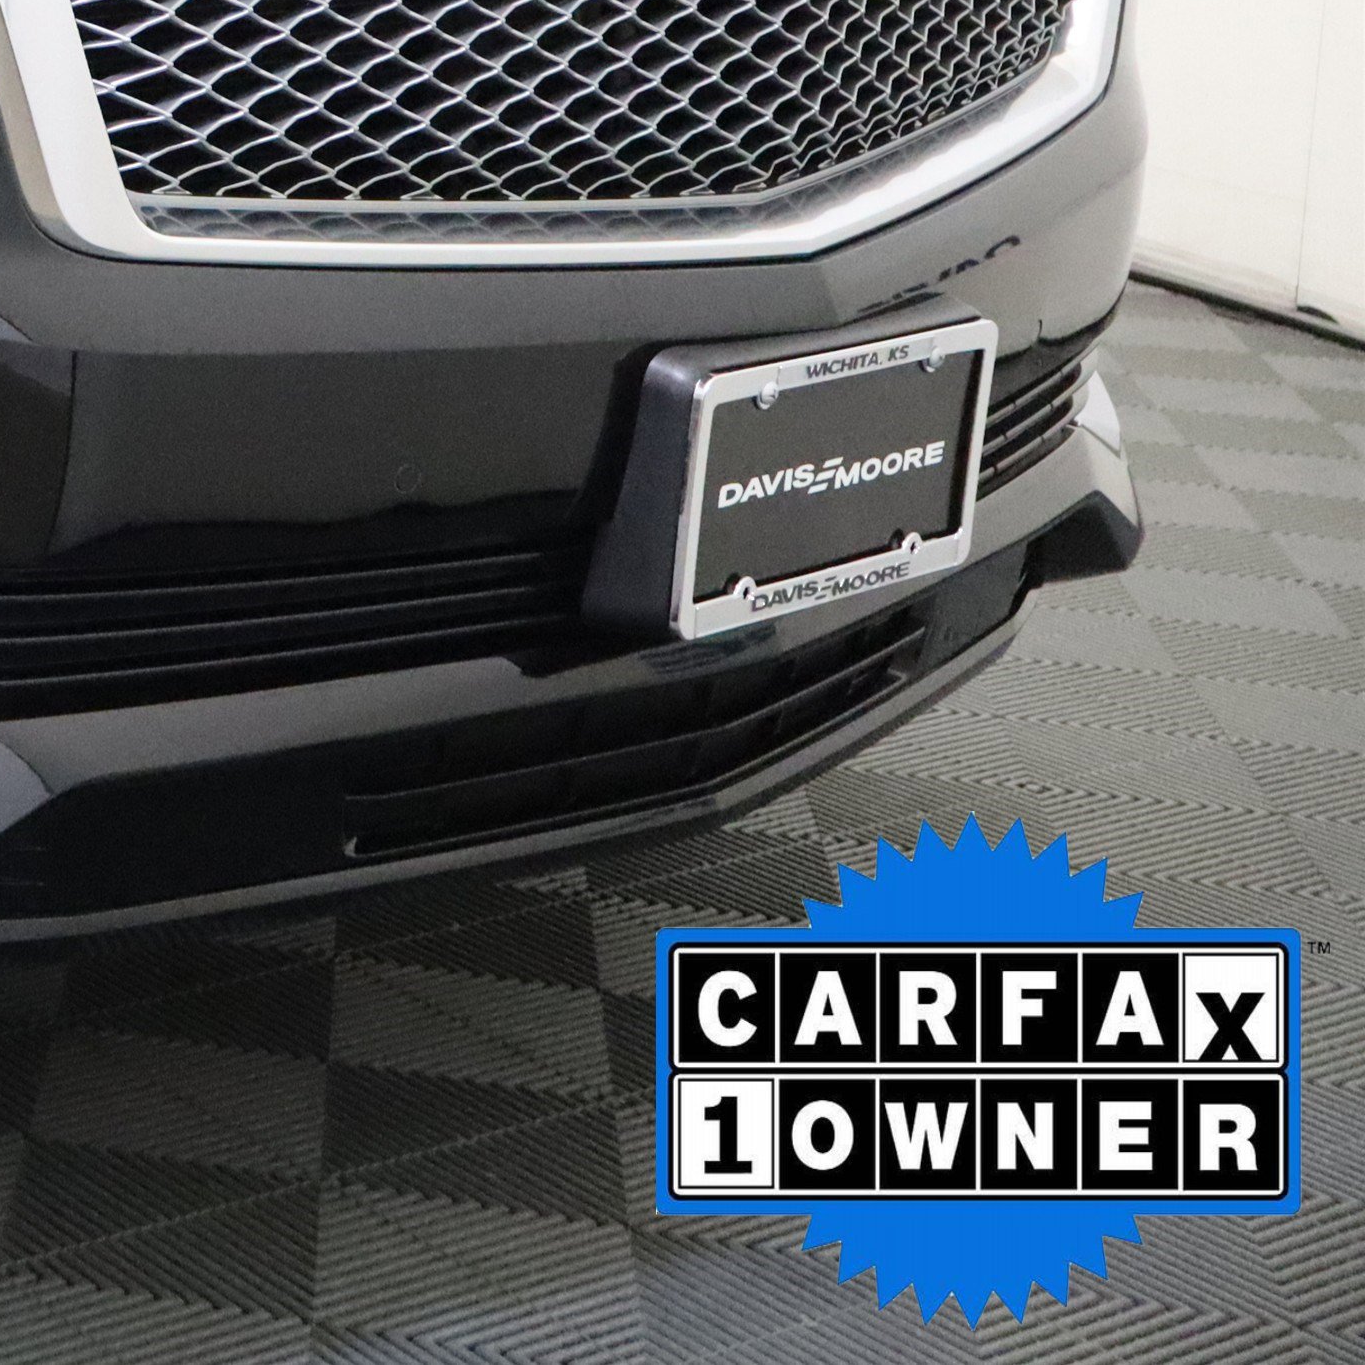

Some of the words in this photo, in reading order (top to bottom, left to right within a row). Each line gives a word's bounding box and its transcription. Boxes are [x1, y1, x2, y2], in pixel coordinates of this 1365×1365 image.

[887, 344, 910, 363] KS
[718, 462, 815, 509] DAVIS
[834, 440, 945, 490] MOORE
[751, 584, 819, 613] DAVIS
[832, 561, 911, 596] MOORE
